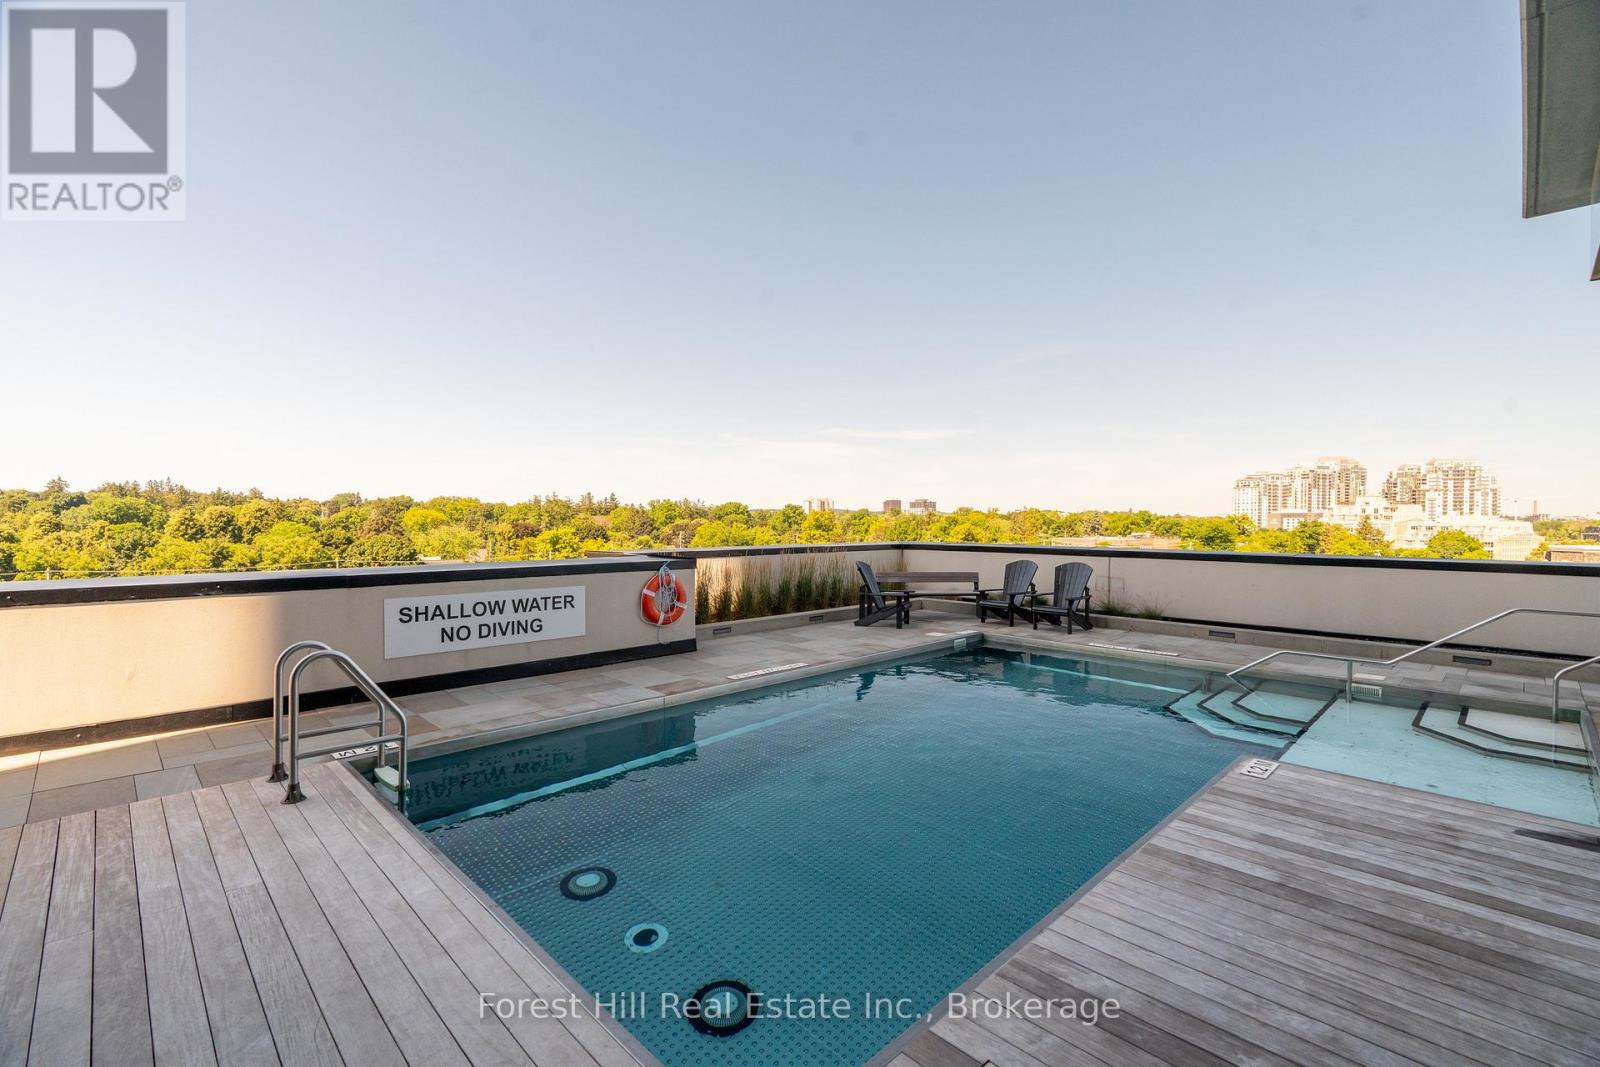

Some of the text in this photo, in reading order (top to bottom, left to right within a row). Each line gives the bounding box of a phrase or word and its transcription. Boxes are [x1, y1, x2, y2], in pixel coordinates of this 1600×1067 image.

[398, 594, 576, 624] SHALLOW WATER
[440, 618, 544, 643] NO DIVING
